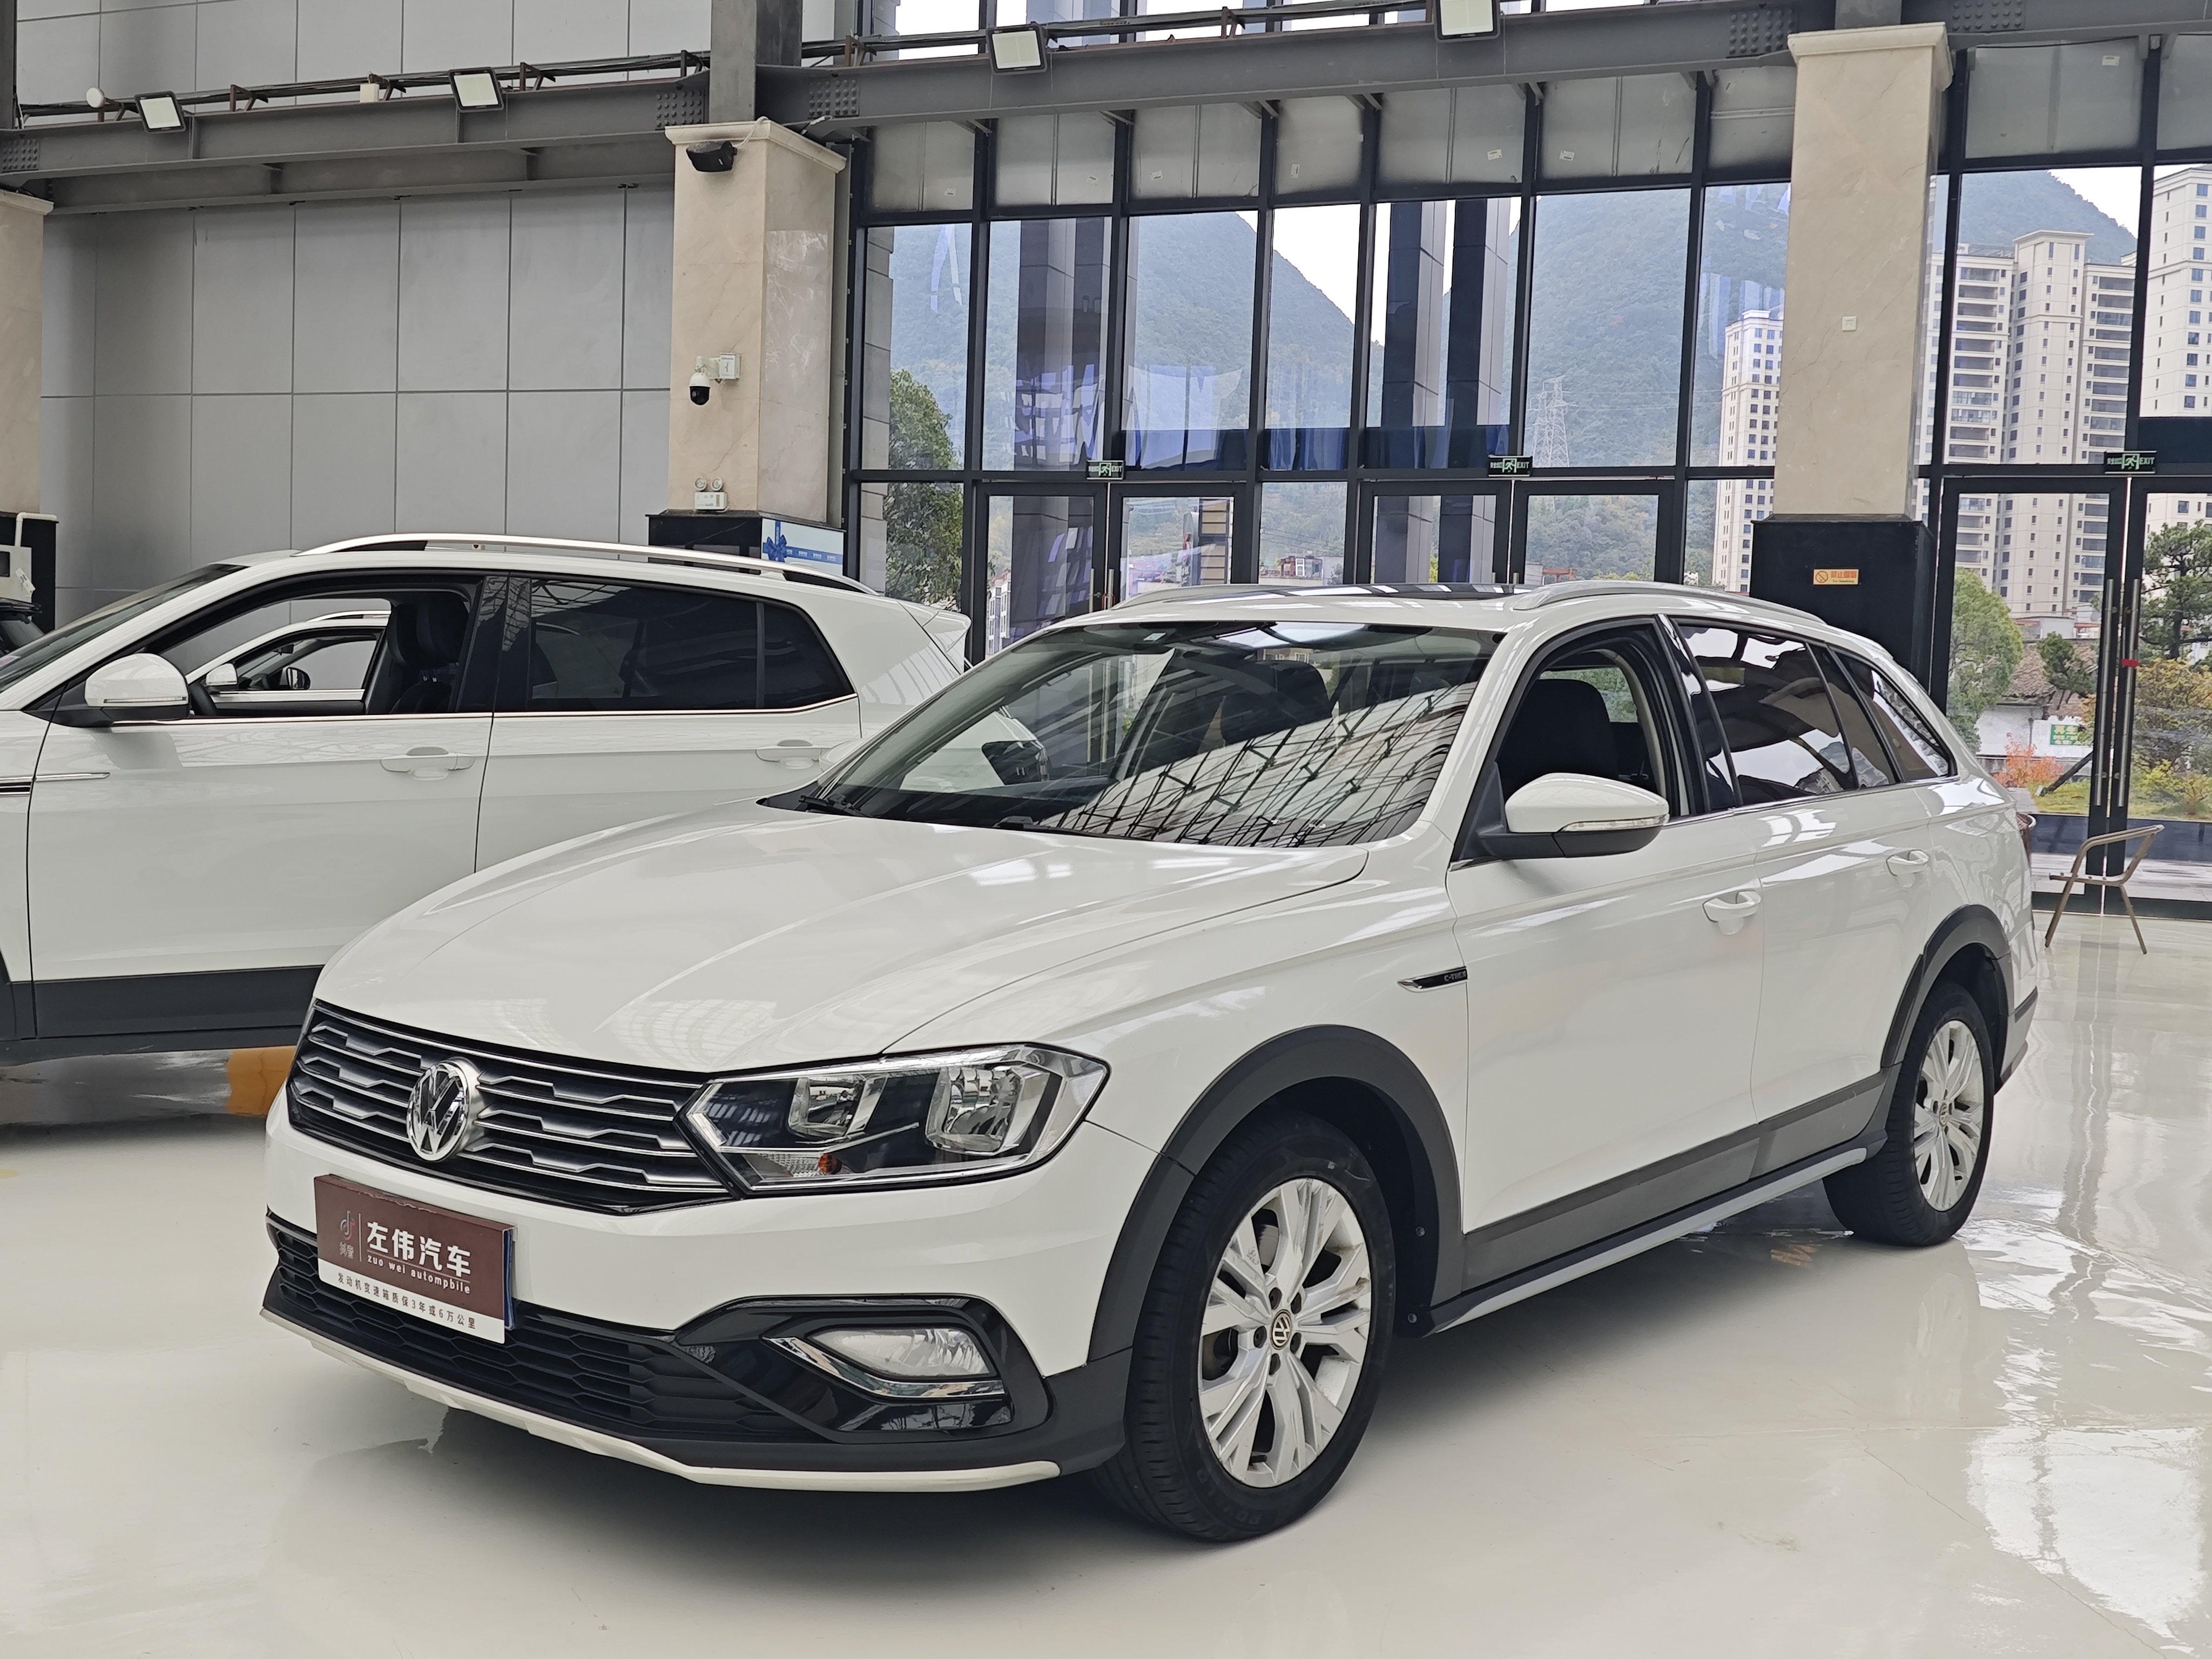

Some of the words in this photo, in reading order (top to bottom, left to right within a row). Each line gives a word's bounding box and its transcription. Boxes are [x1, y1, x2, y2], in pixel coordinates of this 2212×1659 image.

[367, 1222, 471, 1278] 左伟汽车
[367, 1255, 383, 1267] zuo
[389, 1262, 406, 1274] wei
[411, 1270, 471, 1294] autompbile
[338, 1272, 476, 1330] 发动机变速箱质保3年或6万公里
